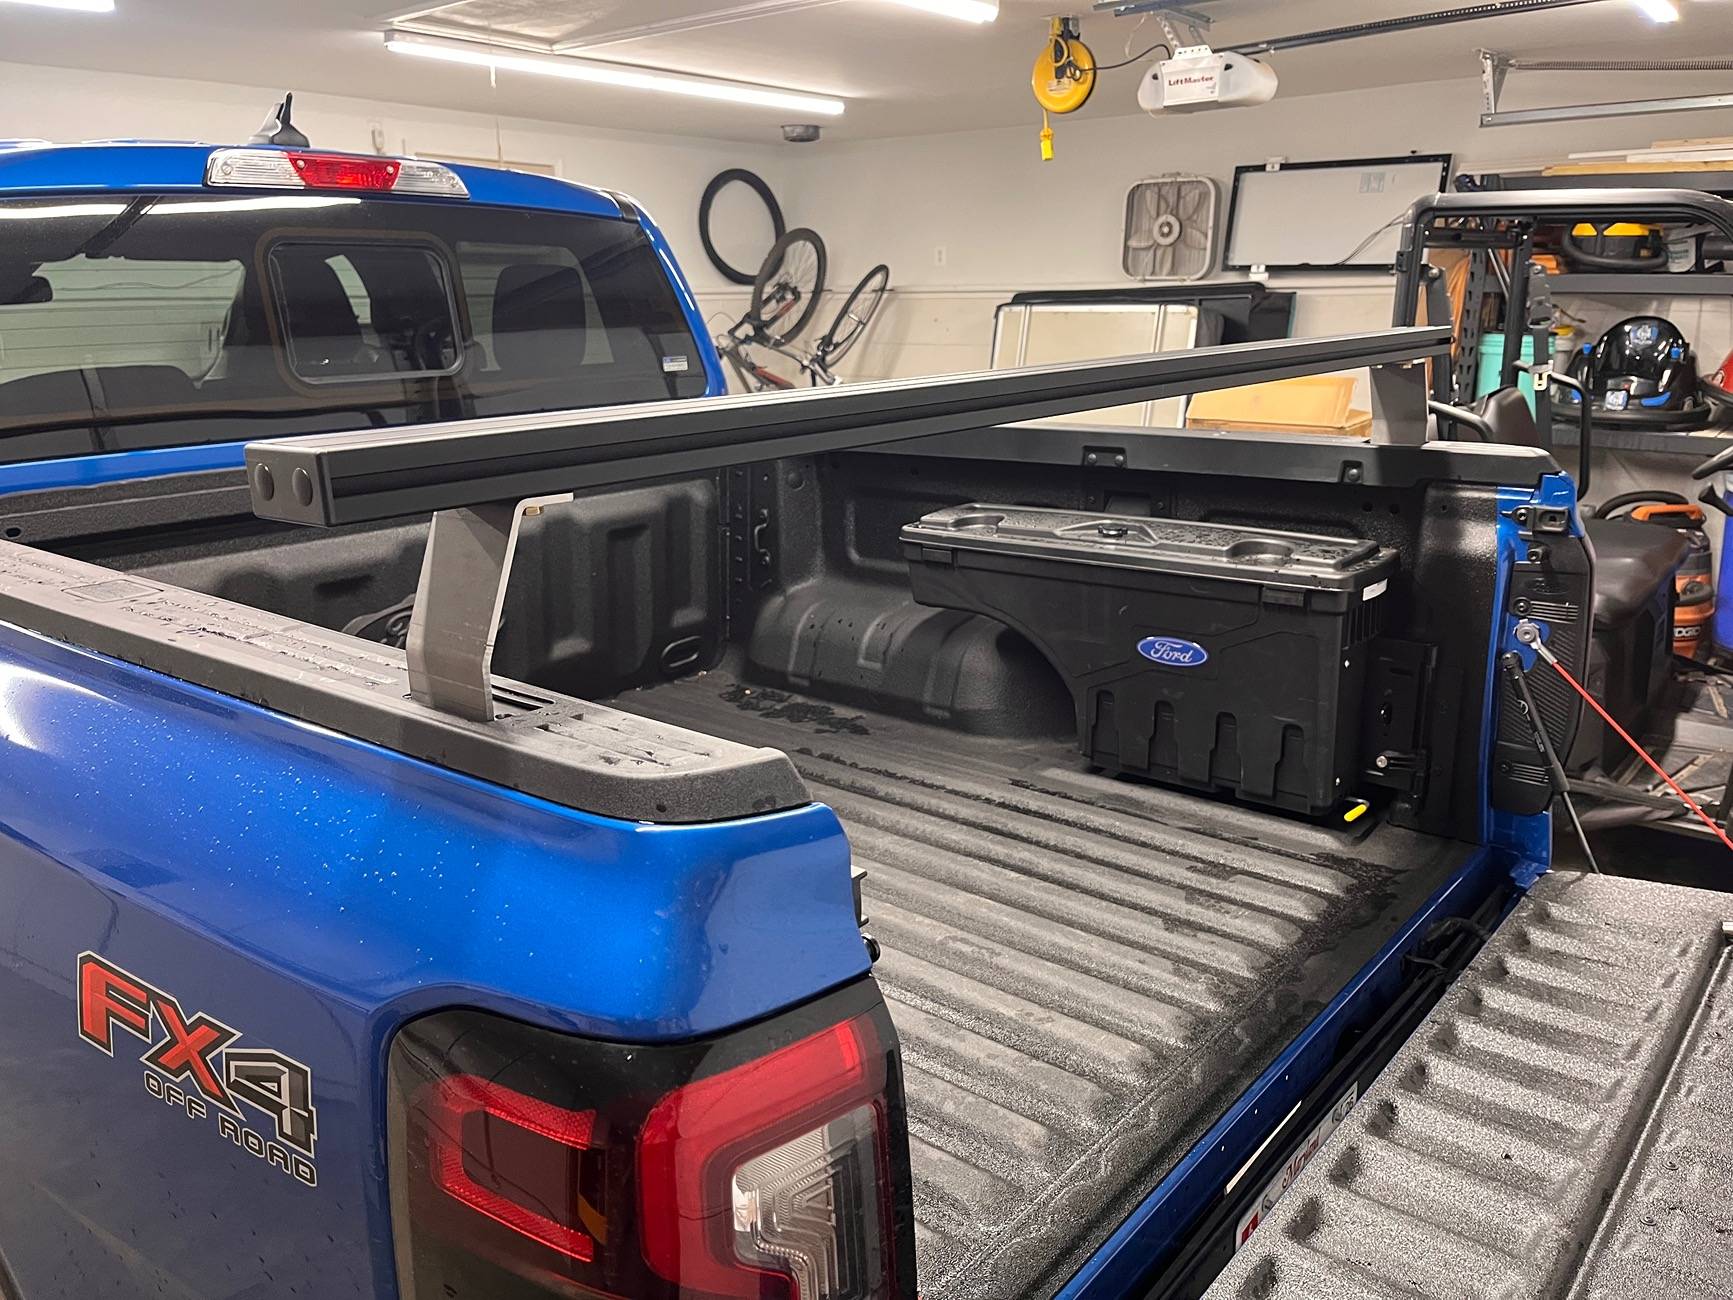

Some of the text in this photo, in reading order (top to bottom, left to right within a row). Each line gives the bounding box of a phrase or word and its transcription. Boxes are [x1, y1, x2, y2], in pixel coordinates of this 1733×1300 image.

[1168, 75, 1214, 87] LiftMaster
[1150, 640, 1194, 662] Ford
[77, 950, 318, 1159] FX4
[143, 1070, 318, 1188] OFF ROAD
